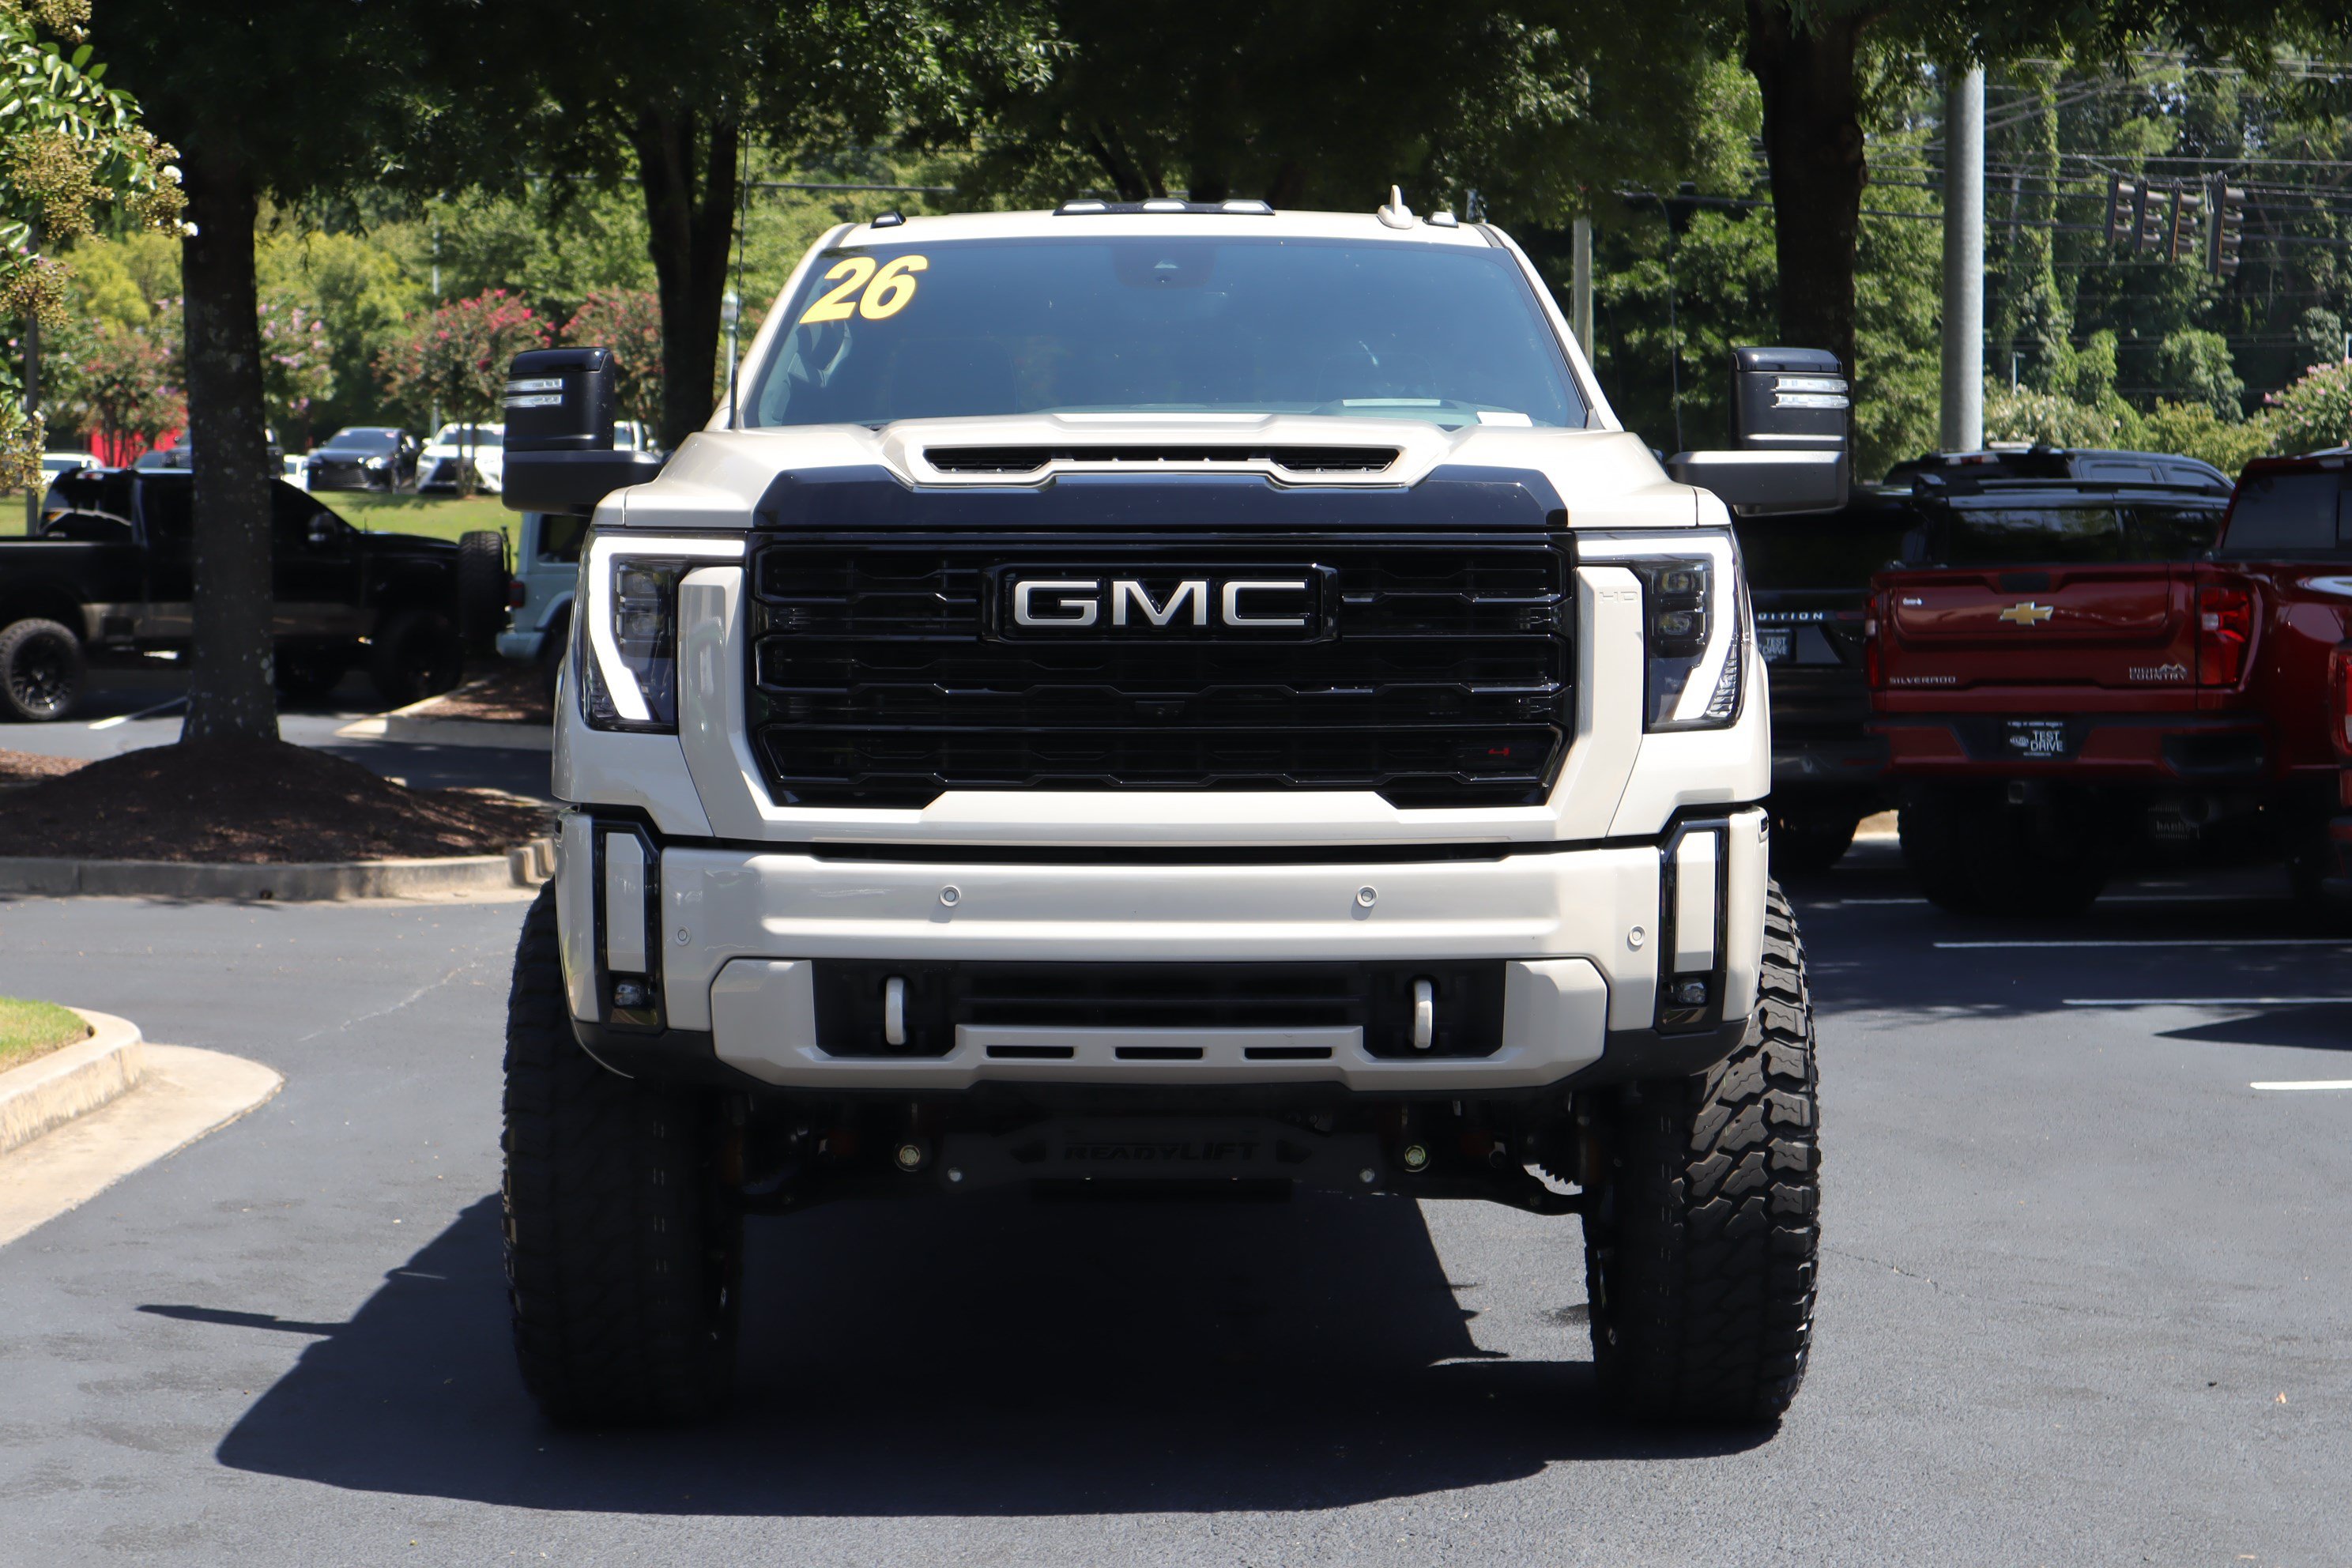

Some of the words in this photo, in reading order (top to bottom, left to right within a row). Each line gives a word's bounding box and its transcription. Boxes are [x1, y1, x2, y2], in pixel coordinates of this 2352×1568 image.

[799, 255, 928, 324] 26
[1014, 581, 1306, 625] GMC
[1599, 591, 1638, 603] HD
[1758, 612, 1824, 620] DITION
[2032, 730, 2060, 741] TEST
[2030, 740, 2063, 752] DRIVE
[1062, 1143, 1260, 1160] READYLIFT
